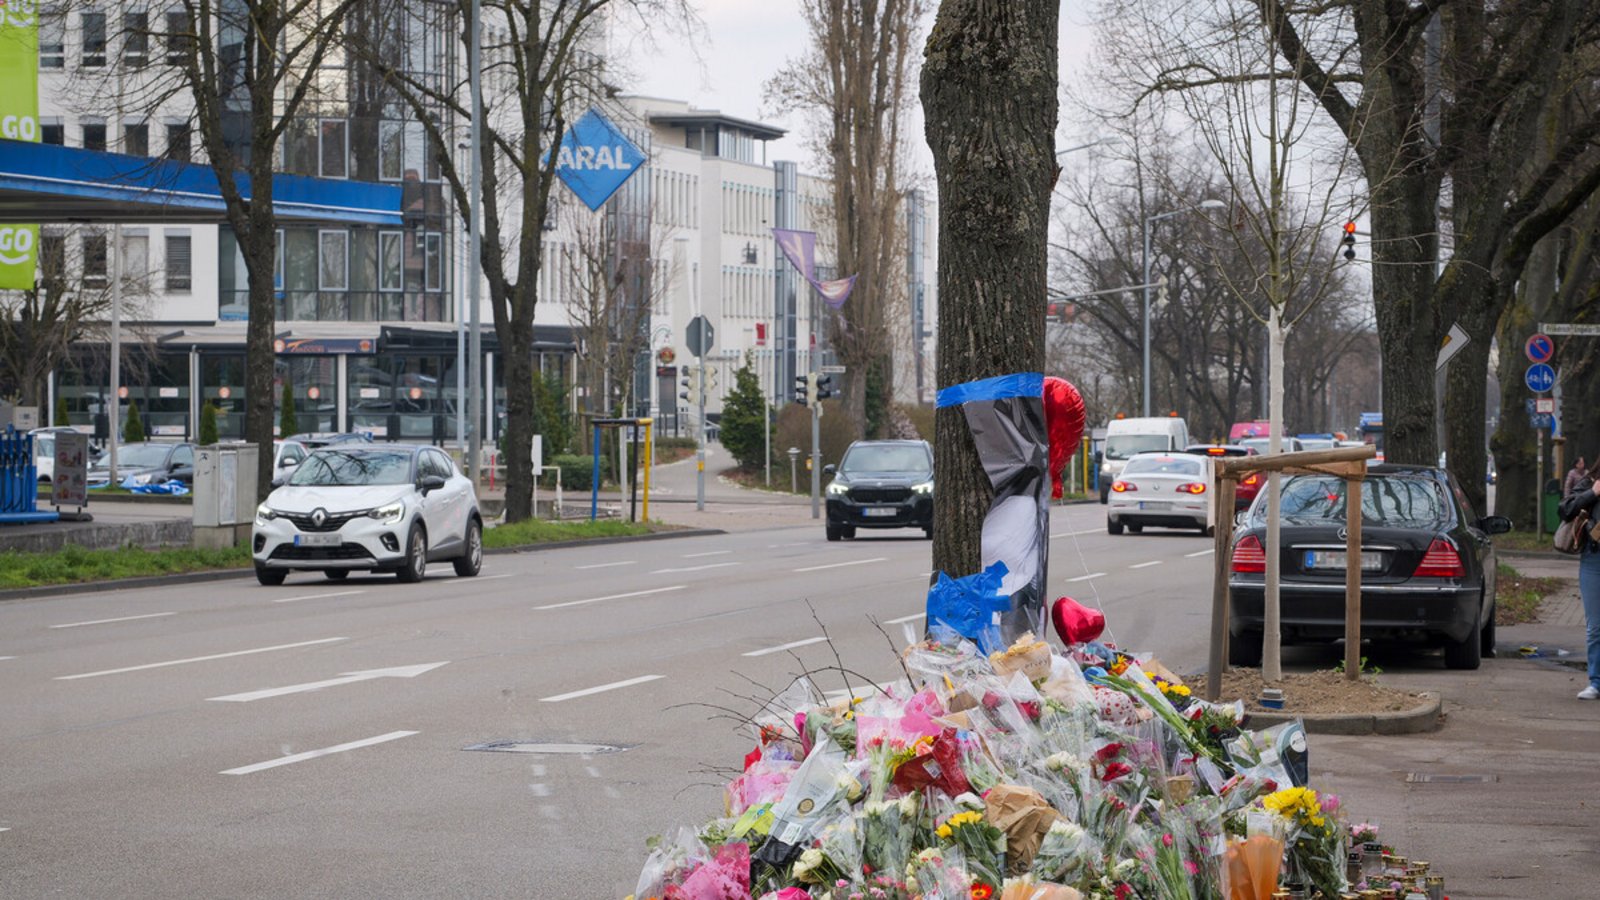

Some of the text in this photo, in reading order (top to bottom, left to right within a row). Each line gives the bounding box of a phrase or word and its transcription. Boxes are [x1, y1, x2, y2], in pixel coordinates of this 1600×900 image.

[3, 116, 34, 140] GO
[555, 145, 632, 170] ARAL
[0, 228, 32, 251] GO
